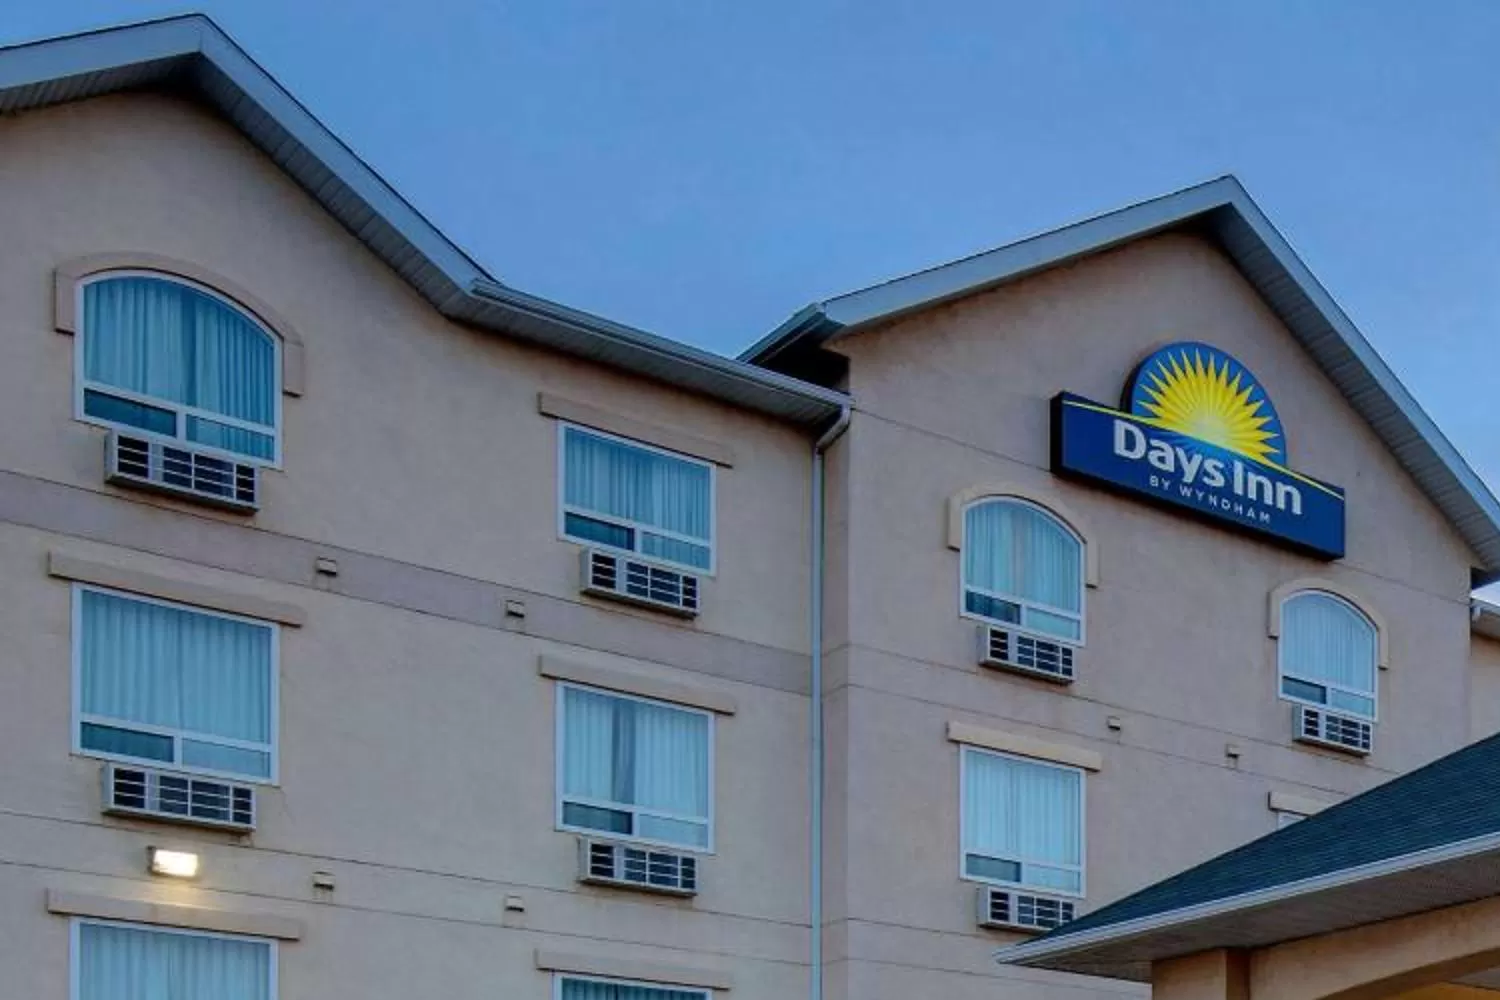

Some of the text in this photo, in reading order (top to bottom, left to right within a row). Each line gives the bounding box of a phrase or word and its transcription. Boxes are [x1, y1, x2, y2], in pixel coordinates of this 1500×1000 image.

[1113, 419, 1302, 515] Days Inn
[1150, 475, 1271, 523] BY WYNDHAM
